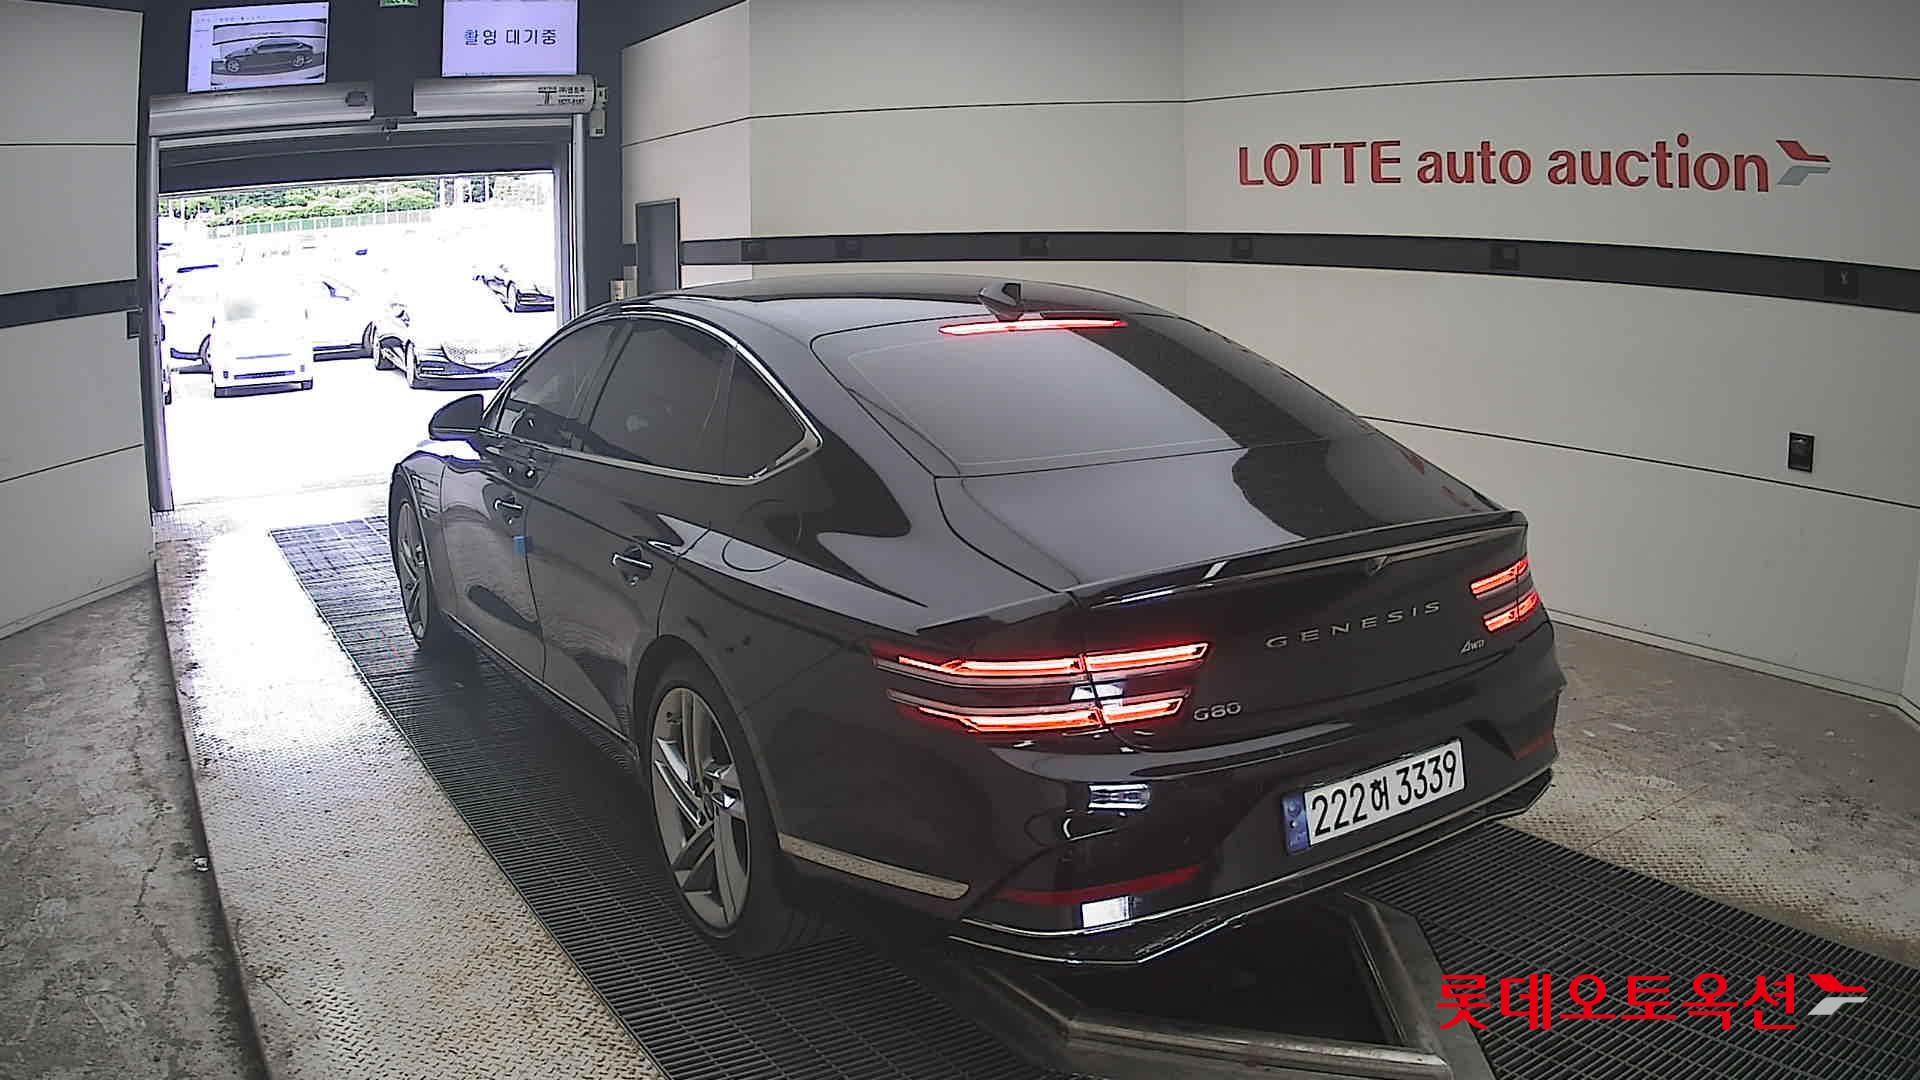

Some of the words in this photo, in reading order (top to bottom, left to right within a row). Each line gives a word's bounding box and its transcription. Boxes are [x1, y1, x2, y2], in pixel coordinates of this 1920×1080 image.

[464, 29, 497, 46] 촬영
[505, 28, 557, 46] 대기중
[1238, 140, 1402, 187] LOTTE
[1416, 140, 1532, 185] auto
[1546, 133, 1770, 193] auction
[1265, 601, 1441, 649] GENESIS
[1193, 702, 1242, 722] G80
[1311, 775, 1390, 837] 222허
[1396, 750, 1457, 806] 3339
